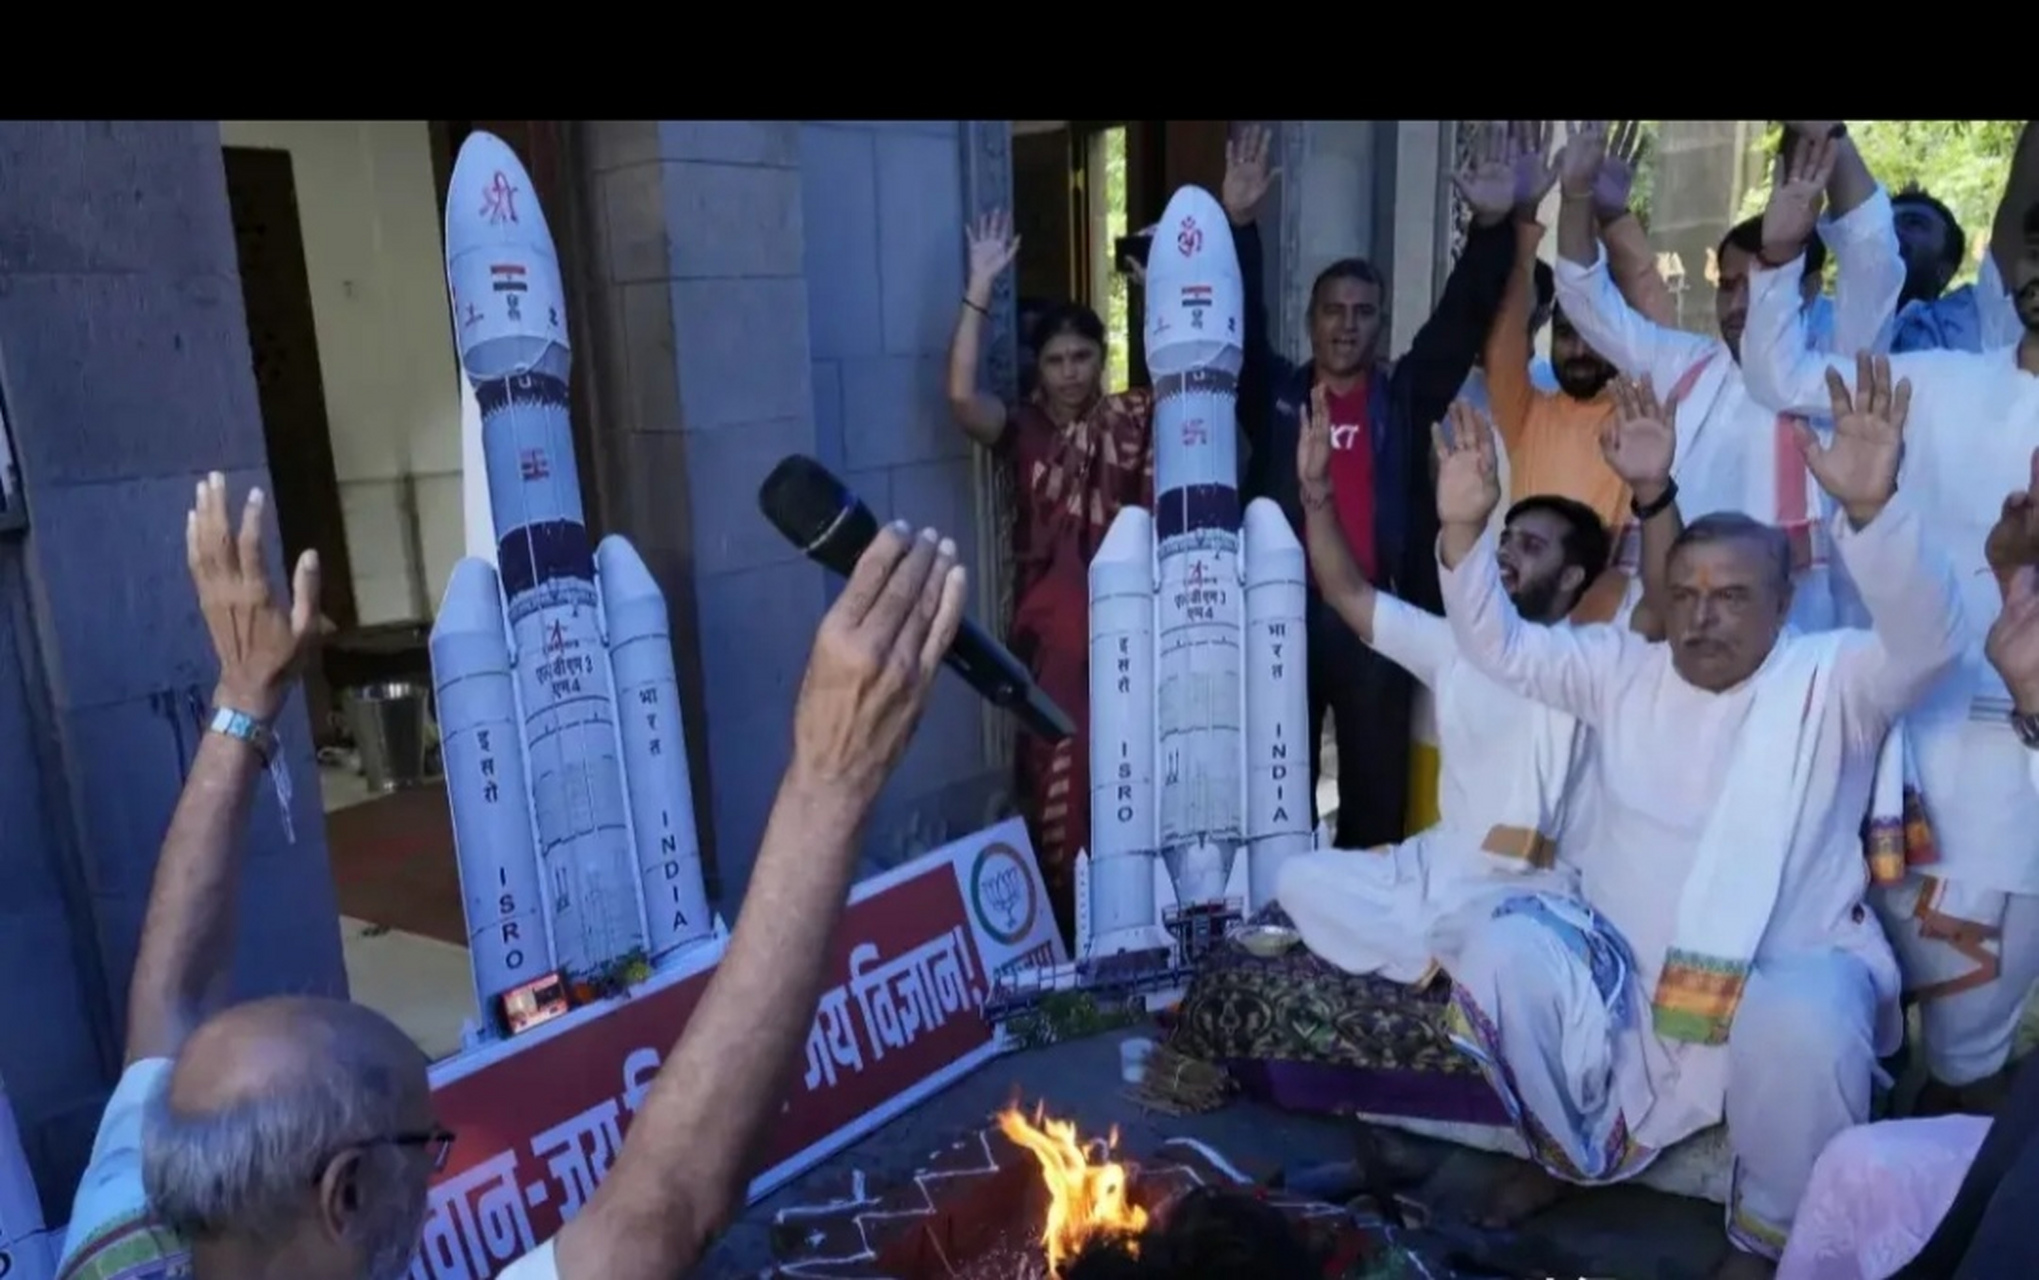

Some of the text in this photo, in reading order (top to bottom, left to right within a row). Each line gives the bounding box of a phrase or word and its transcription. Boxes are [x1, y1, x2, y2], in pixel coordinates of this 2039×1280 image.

[1117, 740, 1134, 823] ISRO
[1270, 722, 1289, 823] INDIA
[497, 866, 524, 971] ISRO
[660, 811, 689, 932] INDIA
[409, 1099, 622, 1280] वान-जय
[849, 923, 984, 1063] विज्ञान!
